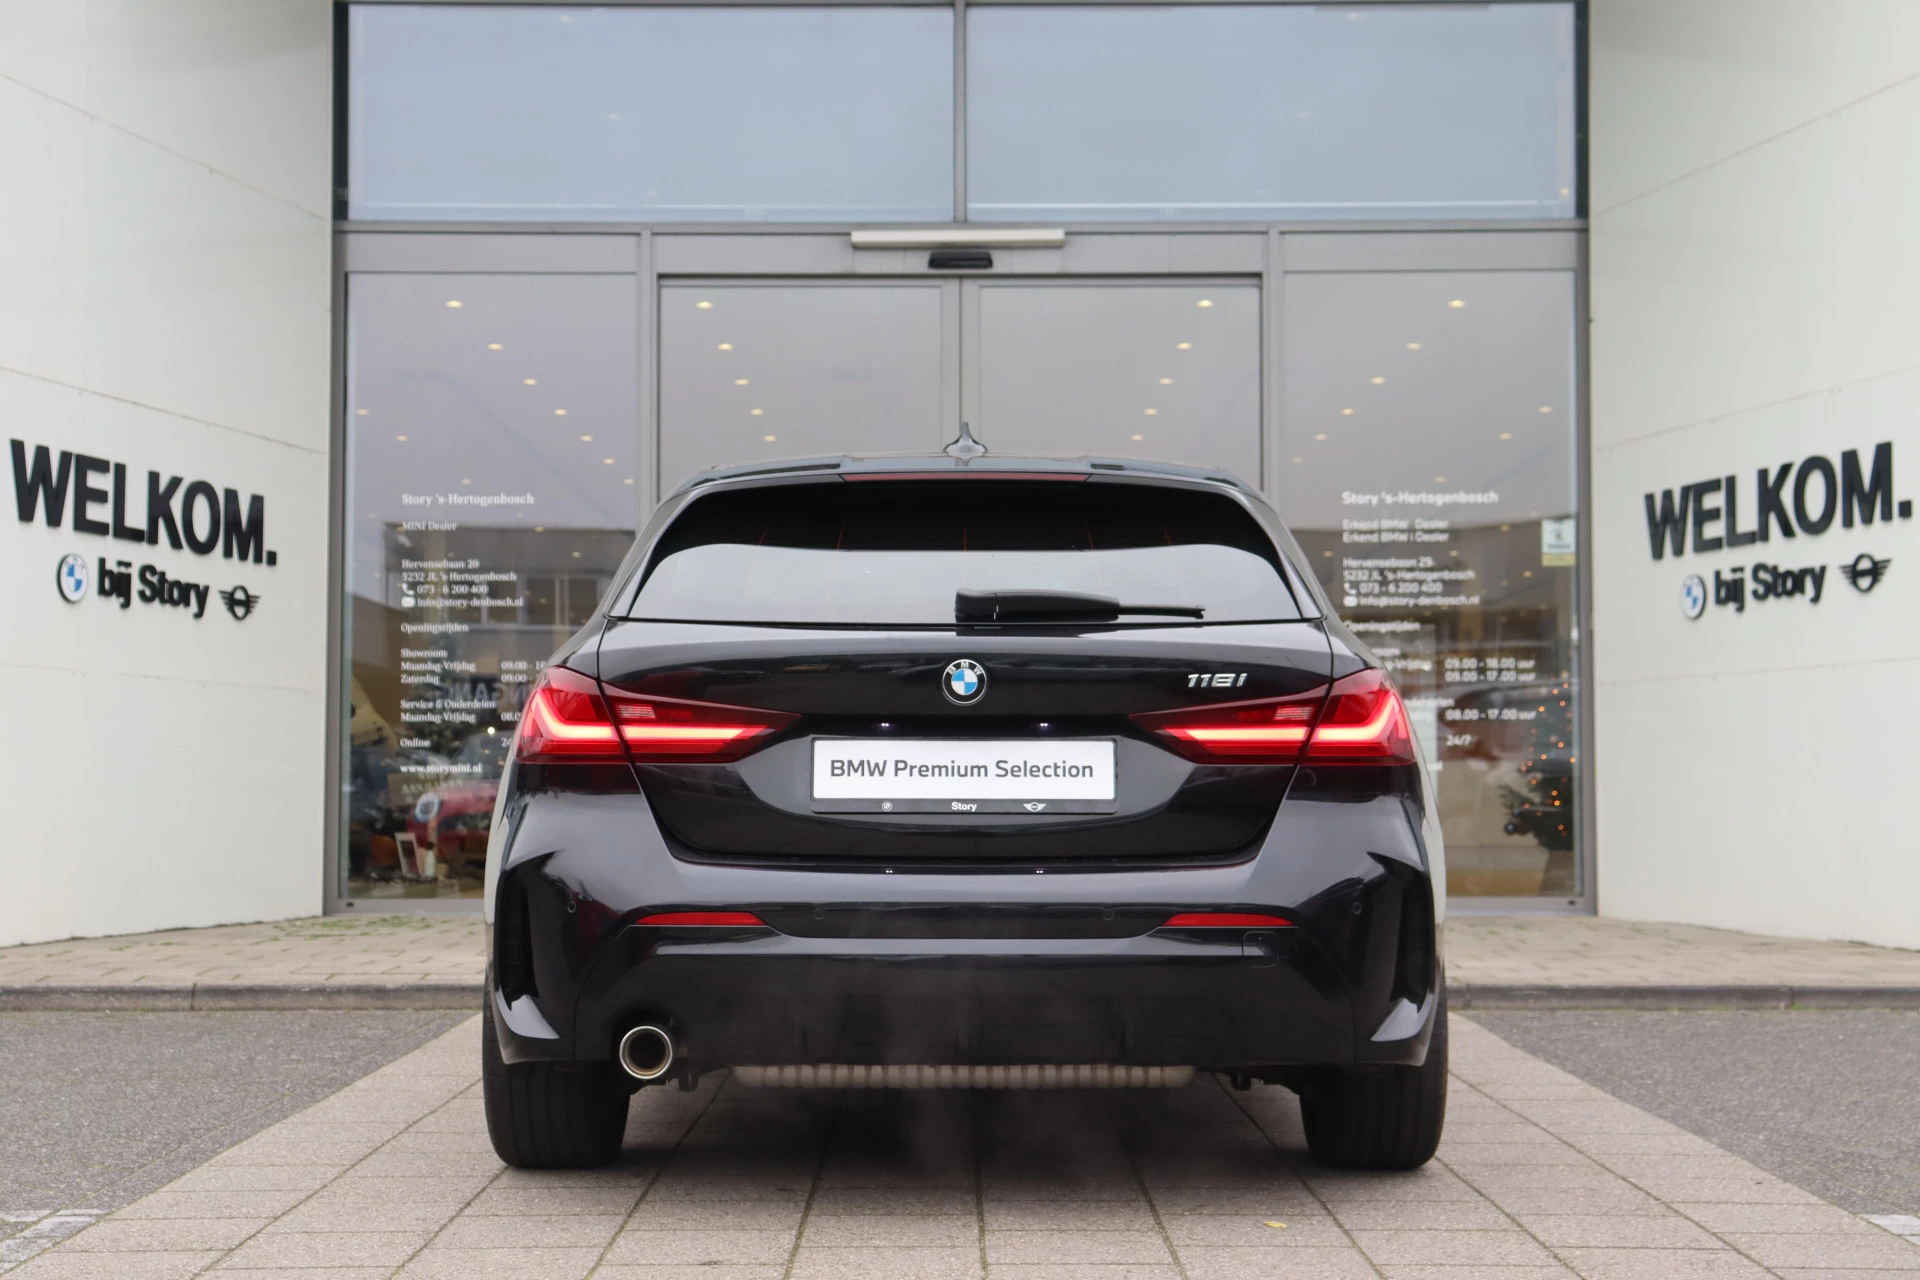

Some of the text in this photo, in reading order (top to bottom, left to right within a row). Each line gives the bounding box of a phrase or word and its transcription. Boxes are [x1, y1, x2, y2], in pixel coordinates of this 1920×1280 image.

[9, 437, 278, 567] WELKOM.
[401, 493, 432, 507] Story
[1342, 490, 1379, 507] Story
[1644, 440, 1913, 561] WELKOM.
[402, 521, 457, 532] MINI Dealer
[1414, 531, 1449, 543] Dealer
[467, 558, 480, 569] 29
[1418, 556, 1433, 568] 29
[401, 571, 424, 582] 5232
[1343, 569, 1370, 580] 5232
[417, 584, 435, 594] 073
[443, 584, 449, 594] 6
[451, 584, 469, 594] 200
[470, 584, 489, 594] 400
[1359, 582, 1380, 594] 073
[1388, 582, 1396, 593] 6
[1397, 582, 1419, 593] 200
[1420, 582, 1443, 593] 400
[1751, 562, 1827, 605] Story
[137, 563, 209, 619] Story
[400, 623, 469, 634] Openingstijden
[400, 648, 447, 658] Showroom
[501, 660, 528, 670] 09.00
[1517, 659, 1536, 669] uur
[400, 674, 440, 685] Zaterdag
[501, 674, 528, 683] 09.00
[1187, 673, 1248, 687] 118i
[1517, 672, 1536, 682] uur
[400, 700, 433, 709] Service
[444, 699, 497, 709] Onderdelen
[501, 712, 521, 721] 08.0
[1517, 710, 1537, 720] uur
[400, 737, 430, 748] Online
[1446, 734, 1472, 746] 24/7
[830, 759, 1094, 778] BMW Premium Selection
[950, 801, 978, 812] Story
